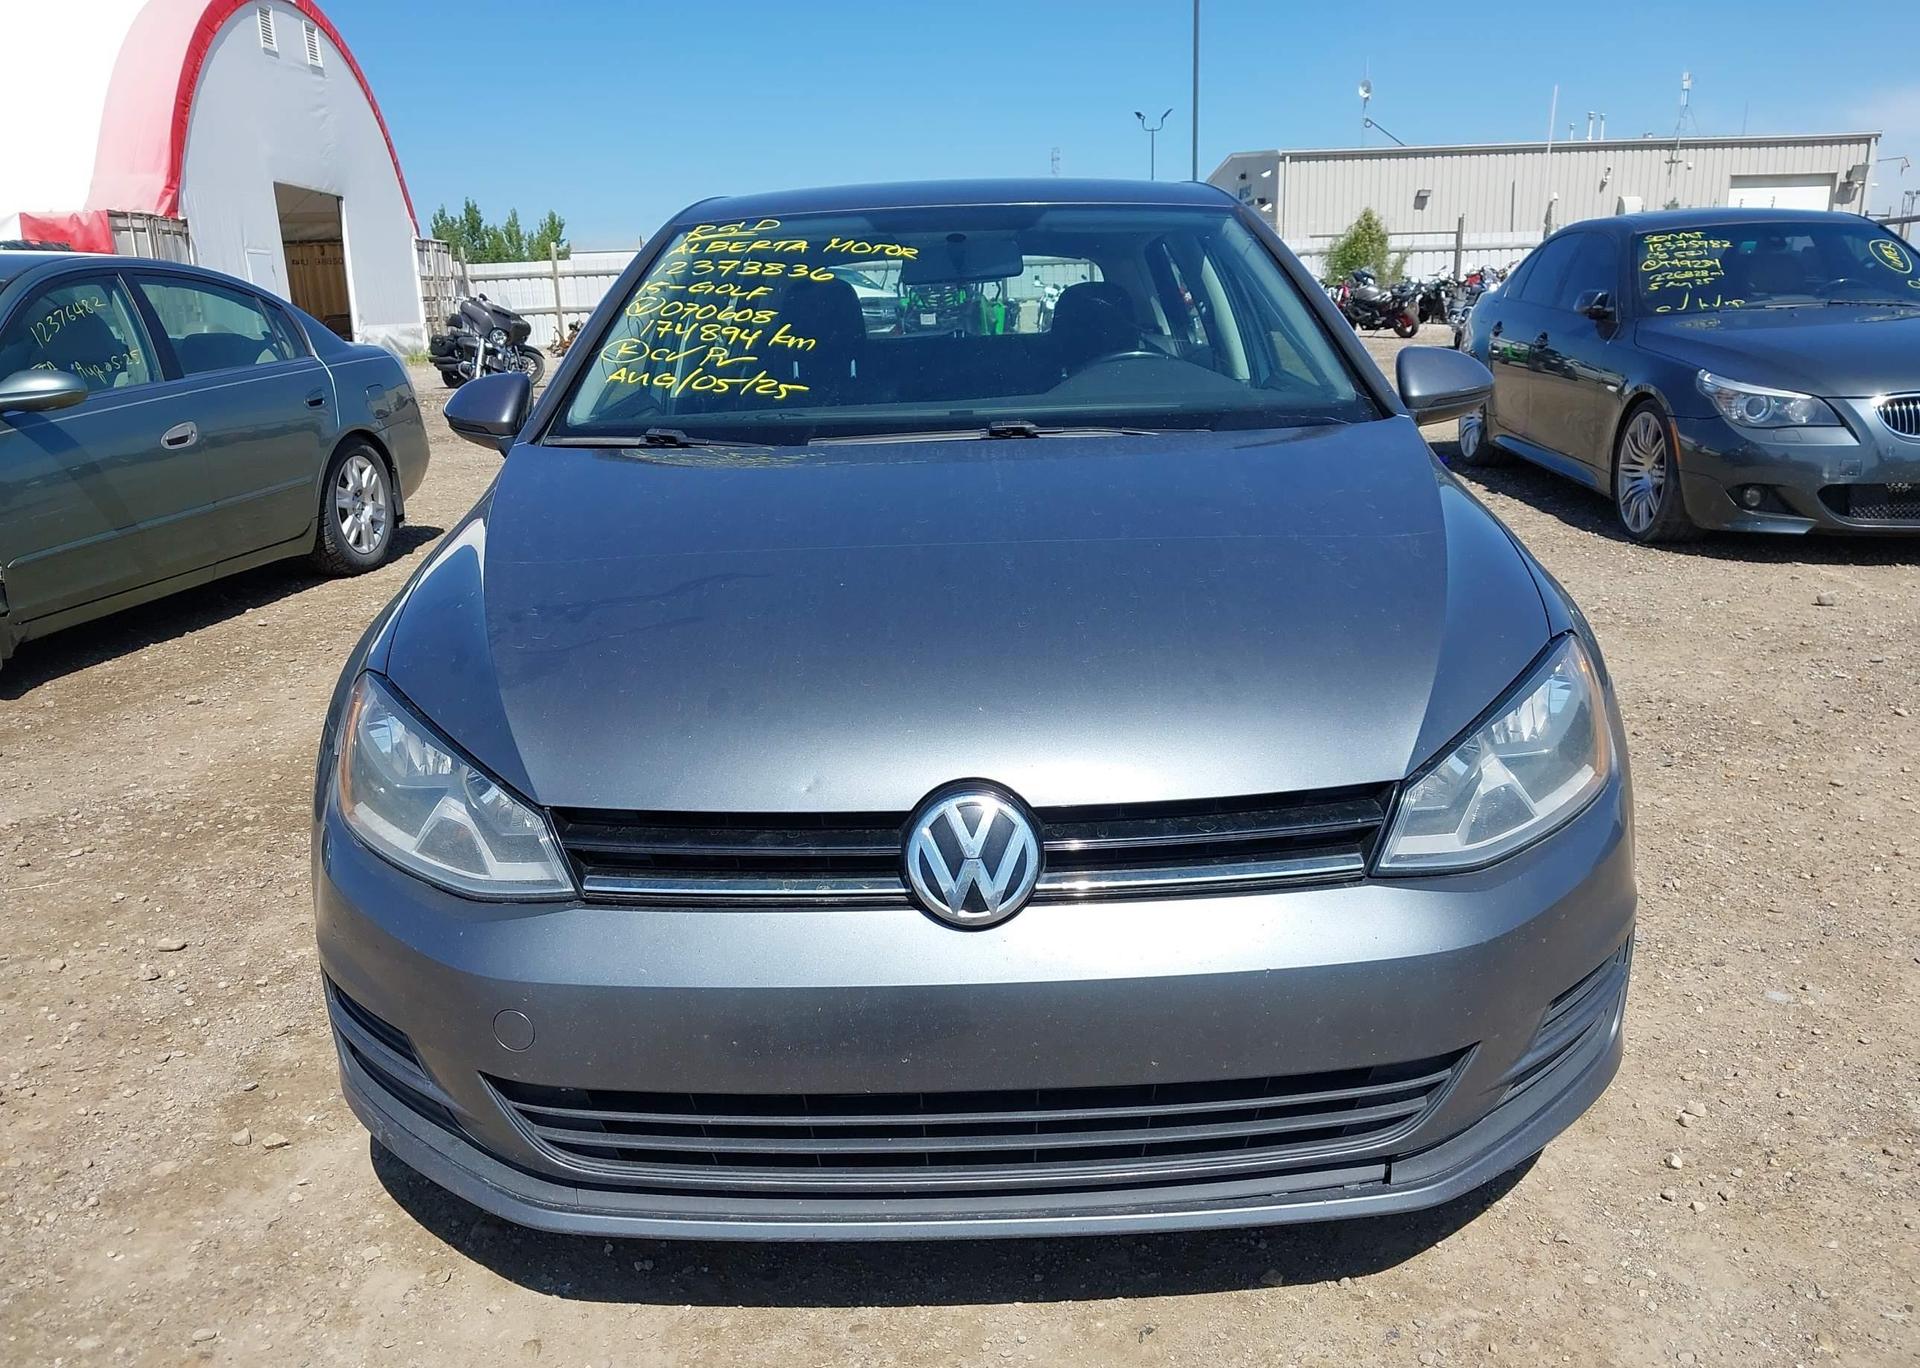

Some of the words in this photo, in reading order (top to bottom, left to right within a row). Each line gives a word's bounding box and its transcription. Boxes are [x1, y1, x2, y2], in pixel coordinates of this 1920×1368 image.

[667, 239, 811, 260] ALBERTA
[824, 236, 920, 260] MOTOR
[652, 258, 836, 282] 12373836
[30, 296, 107, 349] 12376482
[661, 300, 778, 324] 070608
[640, 320, 762, 350] 174894
[907, 790, 1040, 926] VW
